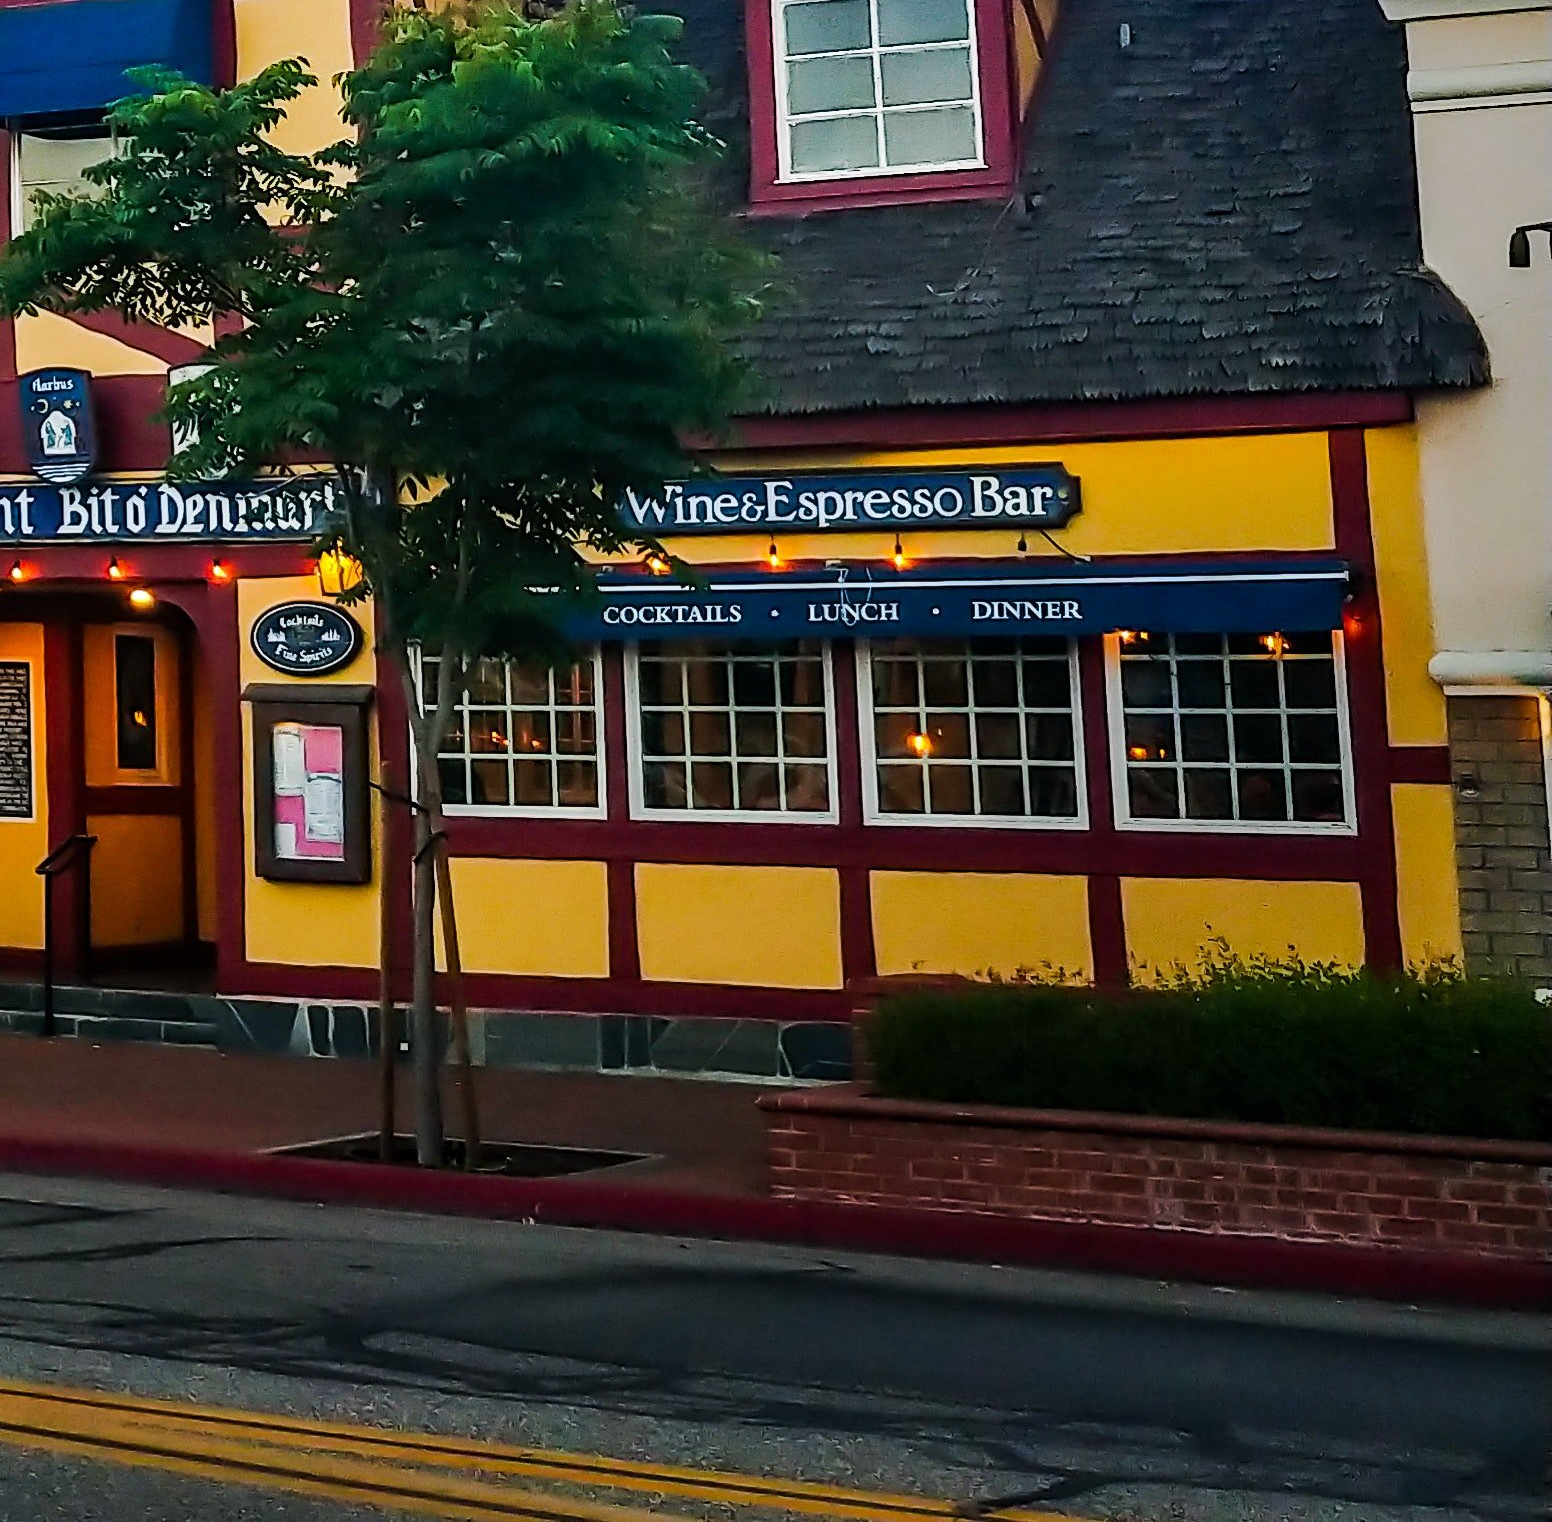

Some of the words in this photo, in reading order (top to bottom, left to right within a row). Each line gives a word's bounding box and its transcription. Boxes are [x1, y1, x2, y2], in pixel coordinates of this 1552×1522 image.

[56, 486, 121, 535] Bit
[969, 475, 1054, 517] Bar
[603, 603, 742, 625] COCKTAILS
[807, 602, 900, 623] LUNCH
[972, 600, 1083, 620] DINNER
